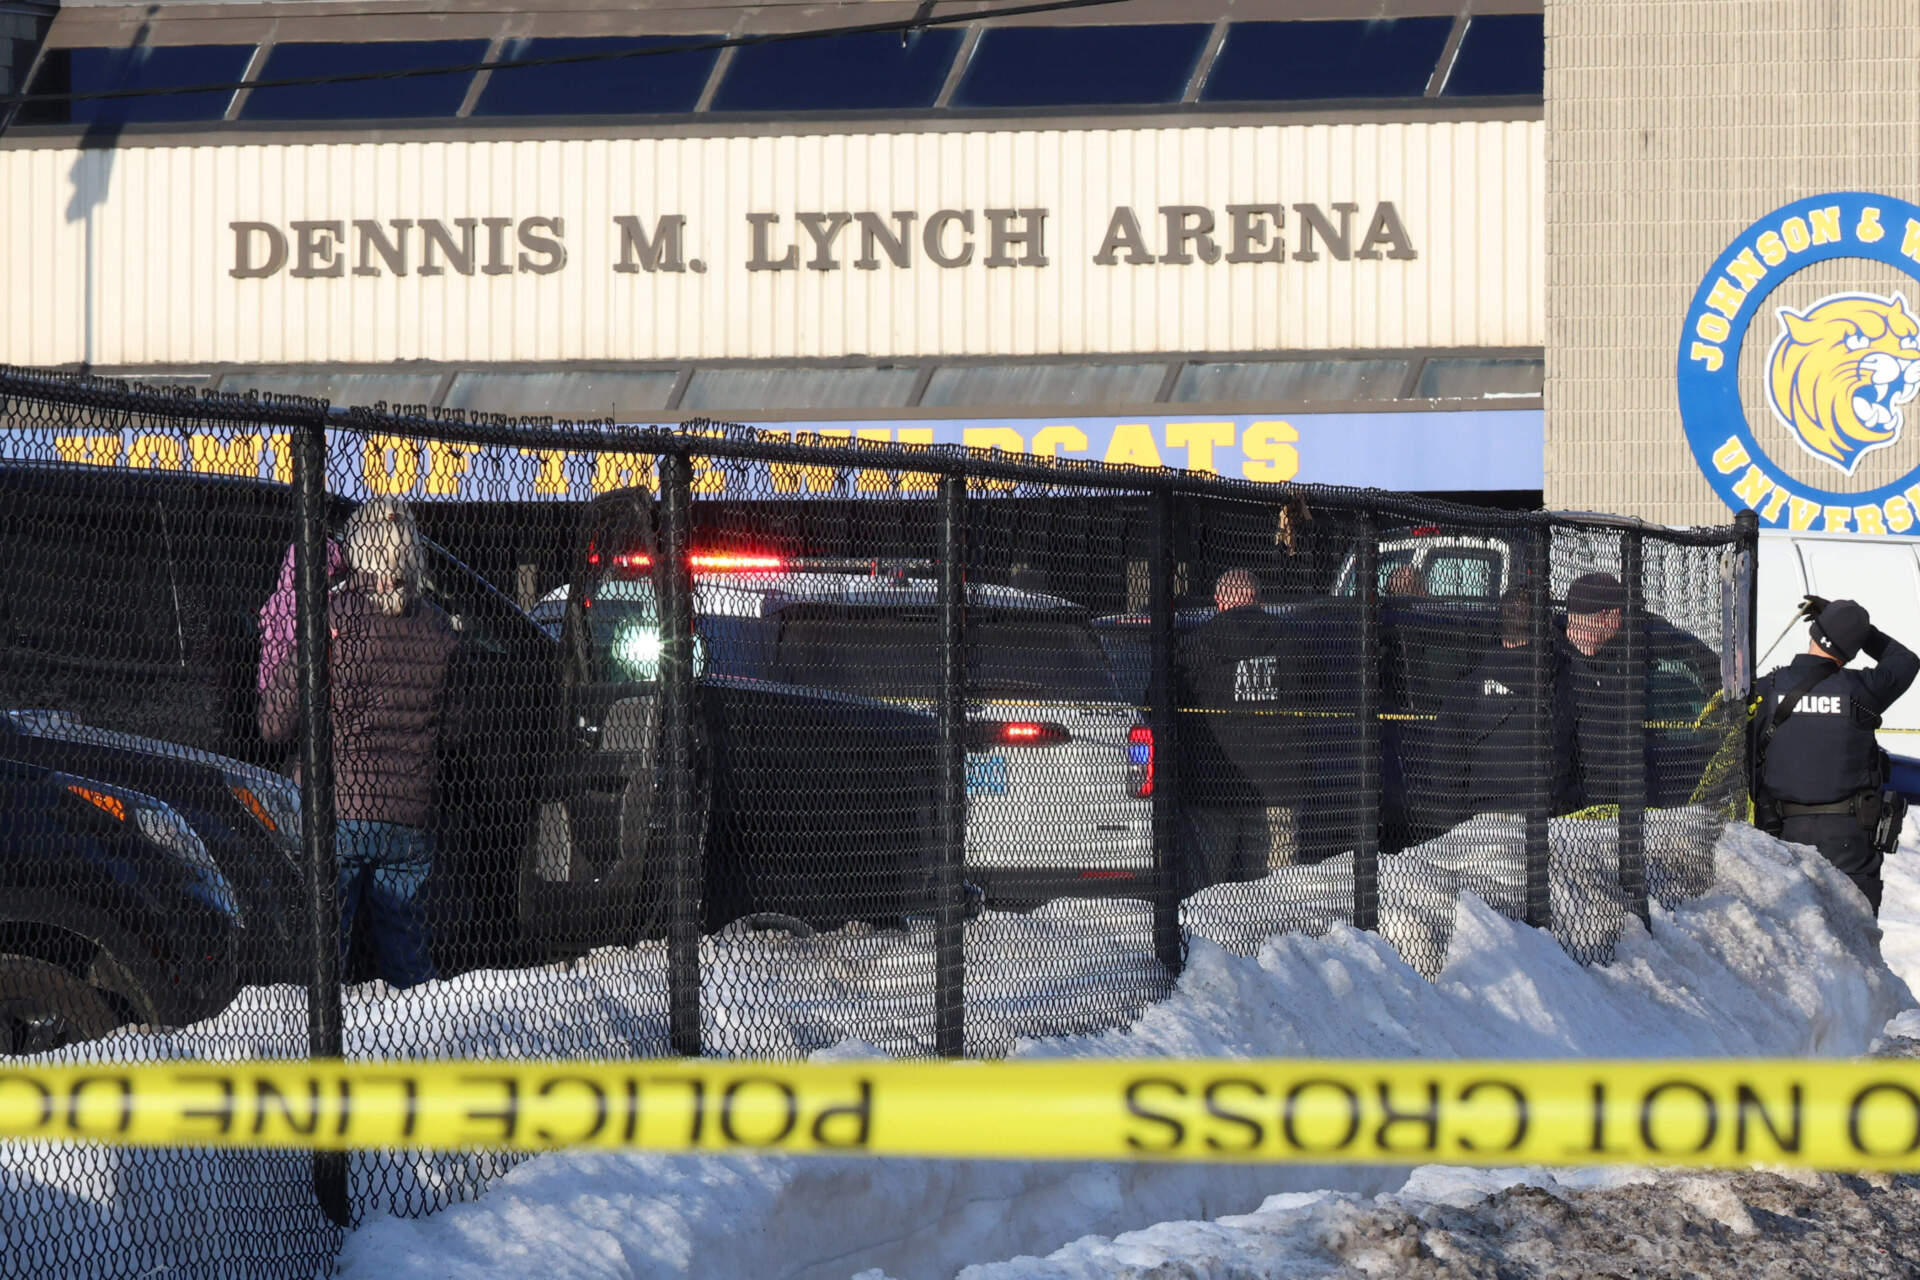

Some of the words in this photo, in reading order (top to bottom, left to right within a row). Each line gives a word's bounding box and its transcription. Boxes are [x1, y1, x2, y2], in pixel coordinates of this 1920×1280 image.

[228, 216, 568, 278] DENNIS
[612, 214, 708, 274] M.
[745, 208, 1050, 272] LYNCH
[1092, 200, 1419, 266] ARENA
[1690, 205, 1842, 372] JOHNSON
[1856, 206, 1885, 244] &
[760, 420, 1299, 492] WILDCATS
[1777, 694, 1841, 714] LICE
[172, 1076, 418, 1139] LINE
[457, 1072, 874, 1148] POLICE
[1122, 1077, 1531, 1153] CROSS
[1562, 1079, 1804, 1155] NOT
